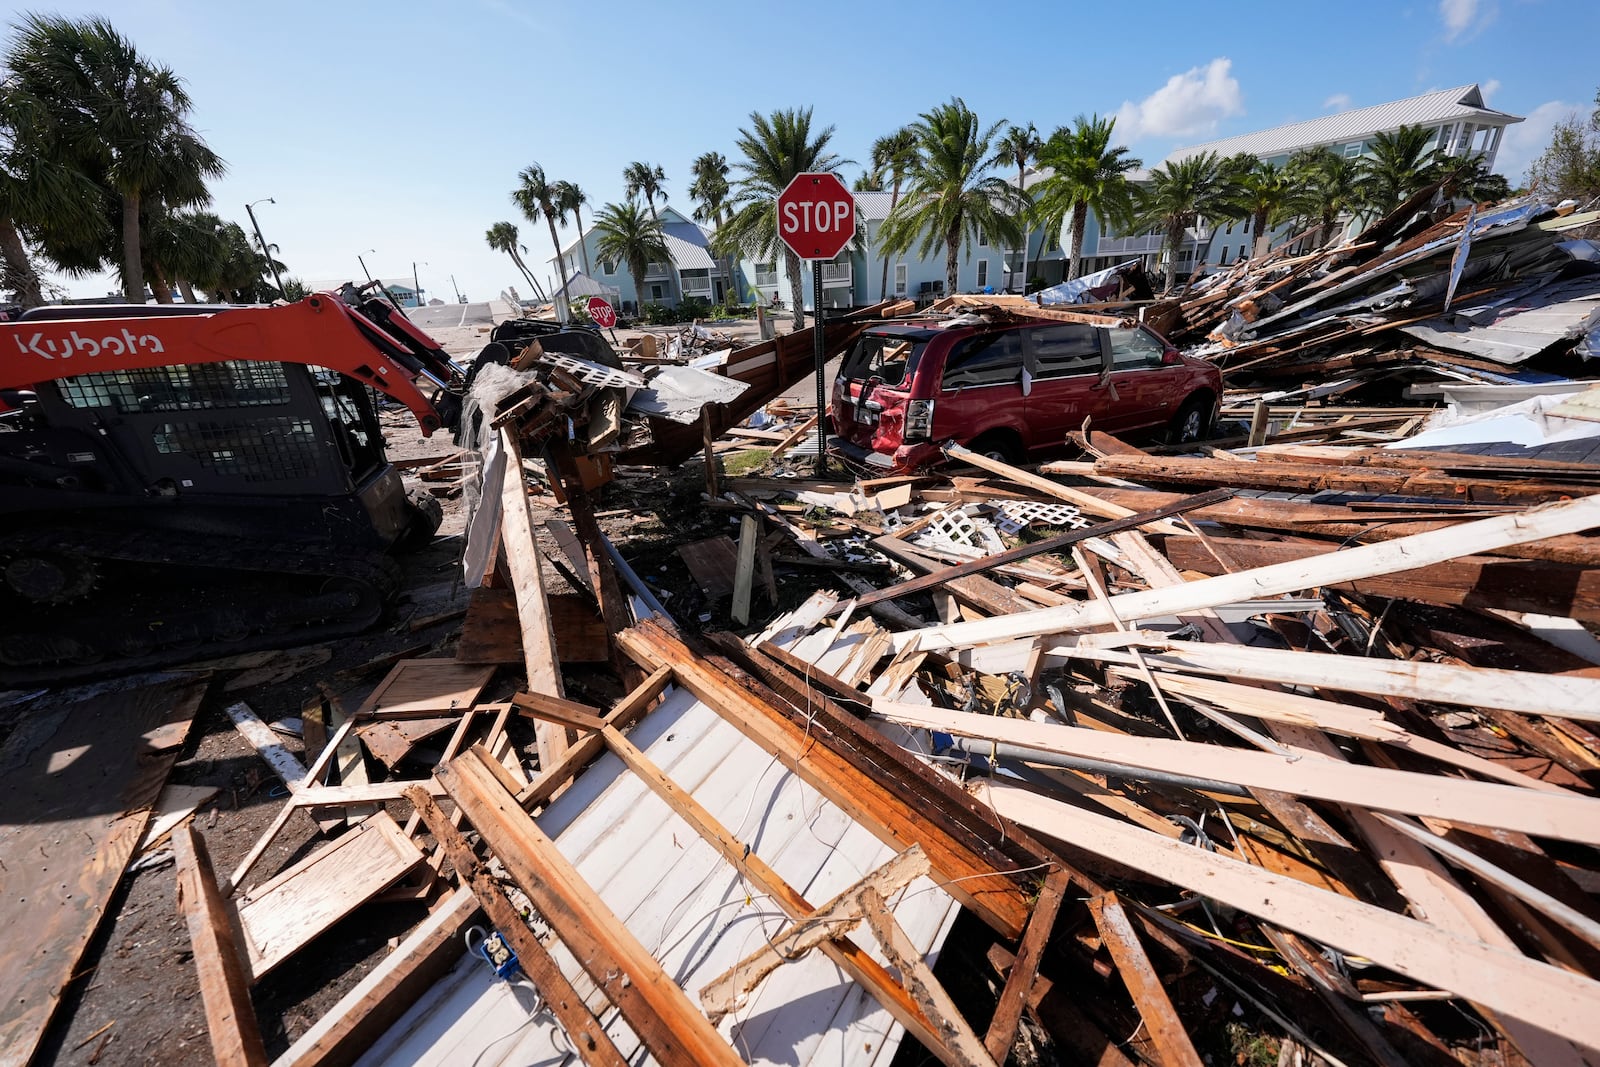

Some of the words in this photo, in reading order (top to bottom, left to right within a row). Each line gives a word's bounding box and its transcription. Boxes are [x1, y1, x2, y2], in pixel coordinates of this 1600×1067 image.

[783, 200, 850, 233] STOP
[591, 305, 612, 319] STOP
[13, 328, 165, 360] Kubota
